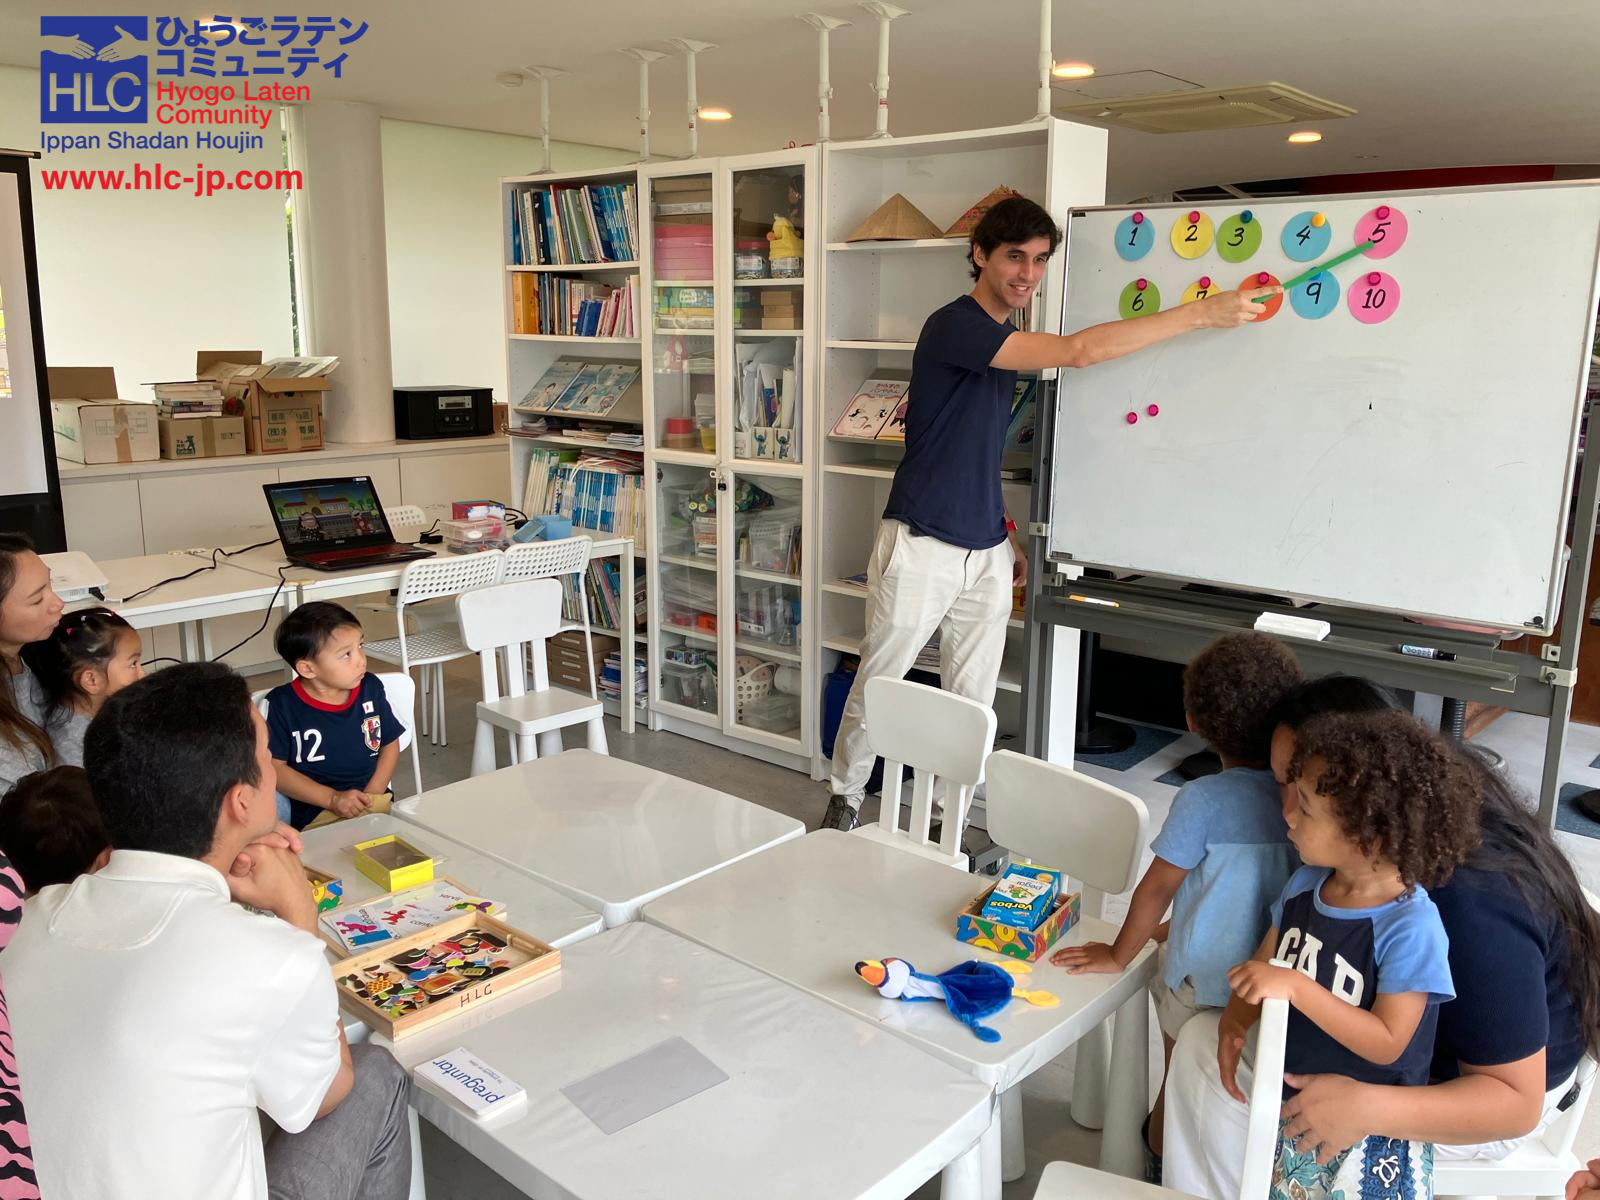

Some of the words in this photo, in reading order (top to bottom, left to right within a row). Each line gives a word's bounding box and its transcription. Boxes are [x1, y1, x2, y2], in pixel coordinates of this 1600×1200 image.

[1128, 226, 1139, 247] 1
[1184, 224, 1198, 242] 2
[1227, 227, 1245, 247] 3
[1296, 225, 1311, 246] 4
[1368, 221, 1392, 244] 5
[1131, 292, 1144, 312] 6
[1306, 282, 1322, 305] 9
[1362, 288, 1386, 309] 10
[291, 728, 326, 763] 12
[991, 901, 1033, 911] Verbos
[432, 1059, 506, 1104] preguntar
